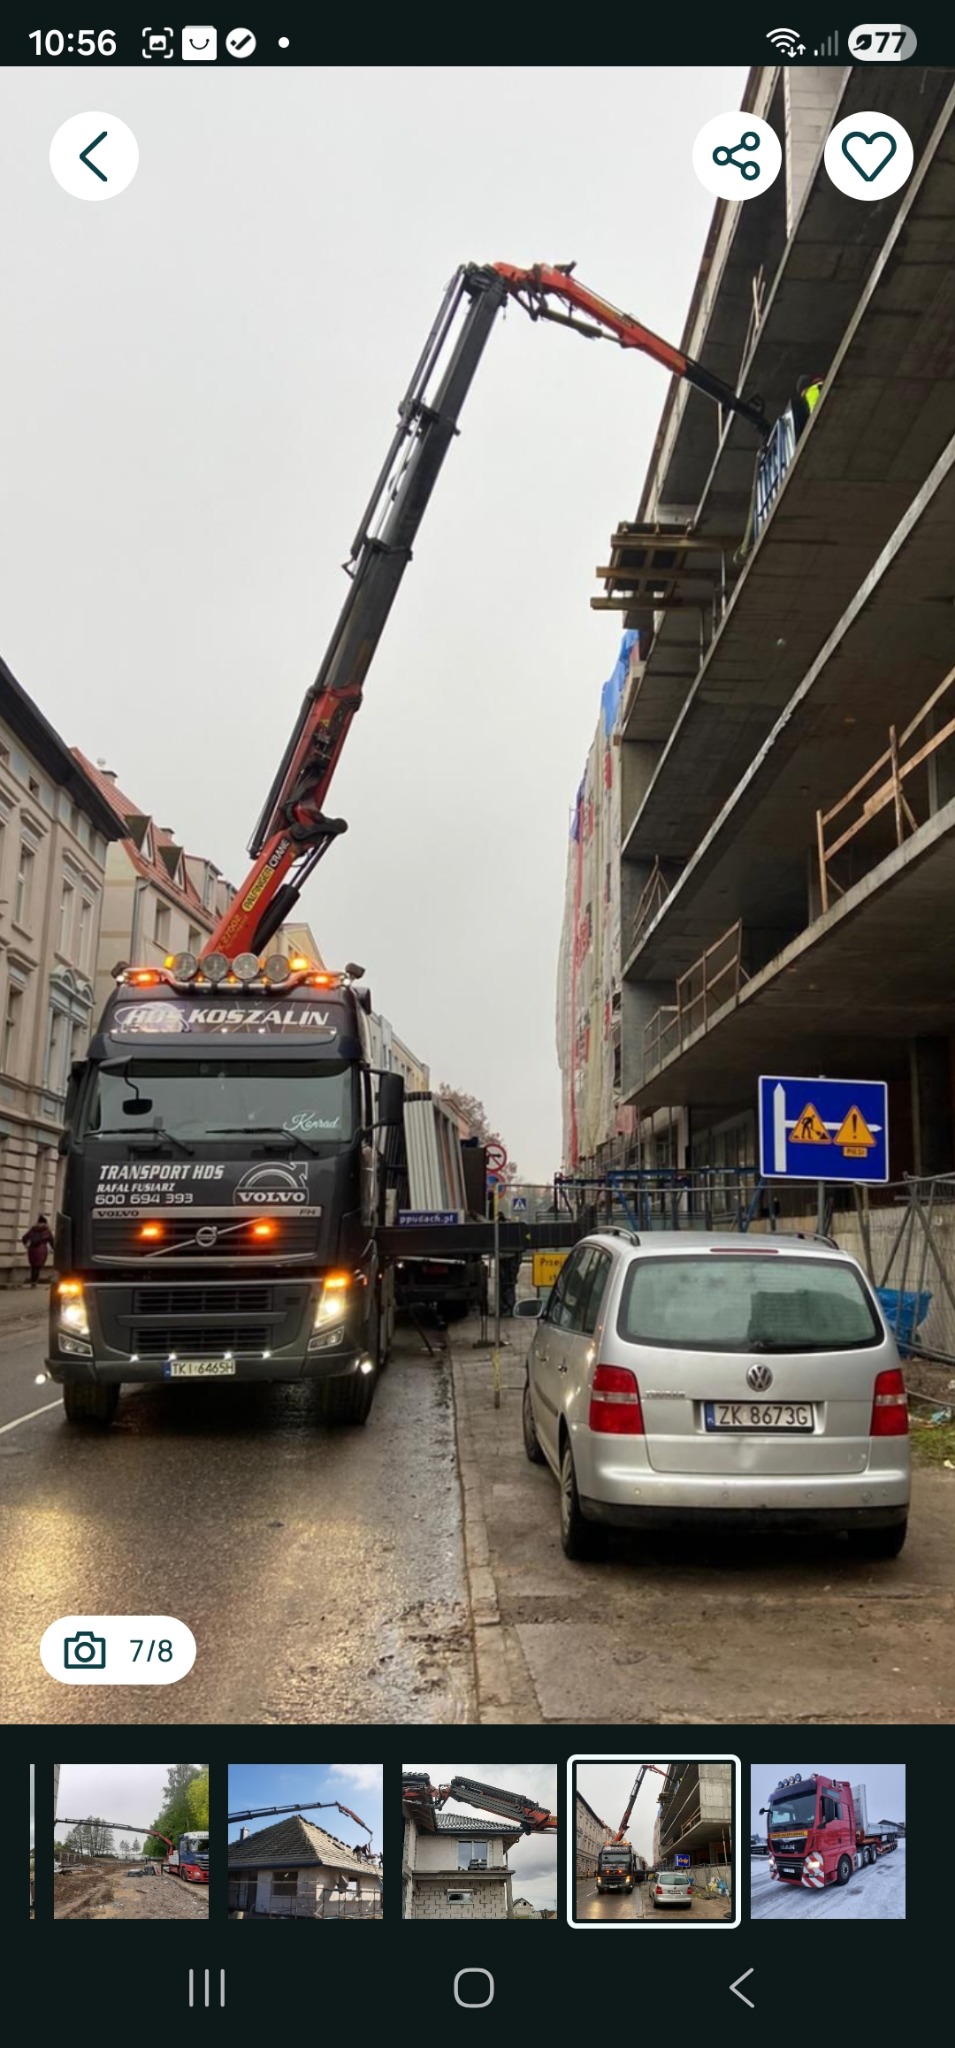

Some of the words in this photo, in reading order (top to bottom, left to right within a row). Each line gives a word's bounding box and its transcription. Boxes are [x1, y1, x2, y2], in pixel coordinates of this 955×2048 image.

[269, 838, 290, 868] CRANE
[124, 1009, 185, 1025] HDS
[188, 1009, 329, 1025] KOSZALIN
[282, 1112, 340, 1131] Konrad
[100, 1165, 191, 1180] TRANSPORT
[192, 1165, 225, 1179] HDS
[131, 1182, 175, 1192] FUSIARZ
[95, 1194, 125, 1205] 600
[130, 1194, 160, 1204] 694
[165, 1193, 193, 1204] 393
[237, 1191, 306, 1203] VOLVO
[173, 1363, 192, 1375] TKI
[198, 1361, 234, 1374] 6465H
[719, 1406, 742, 1424] ZK
[751, 1406, 808, 1425] 8673G
